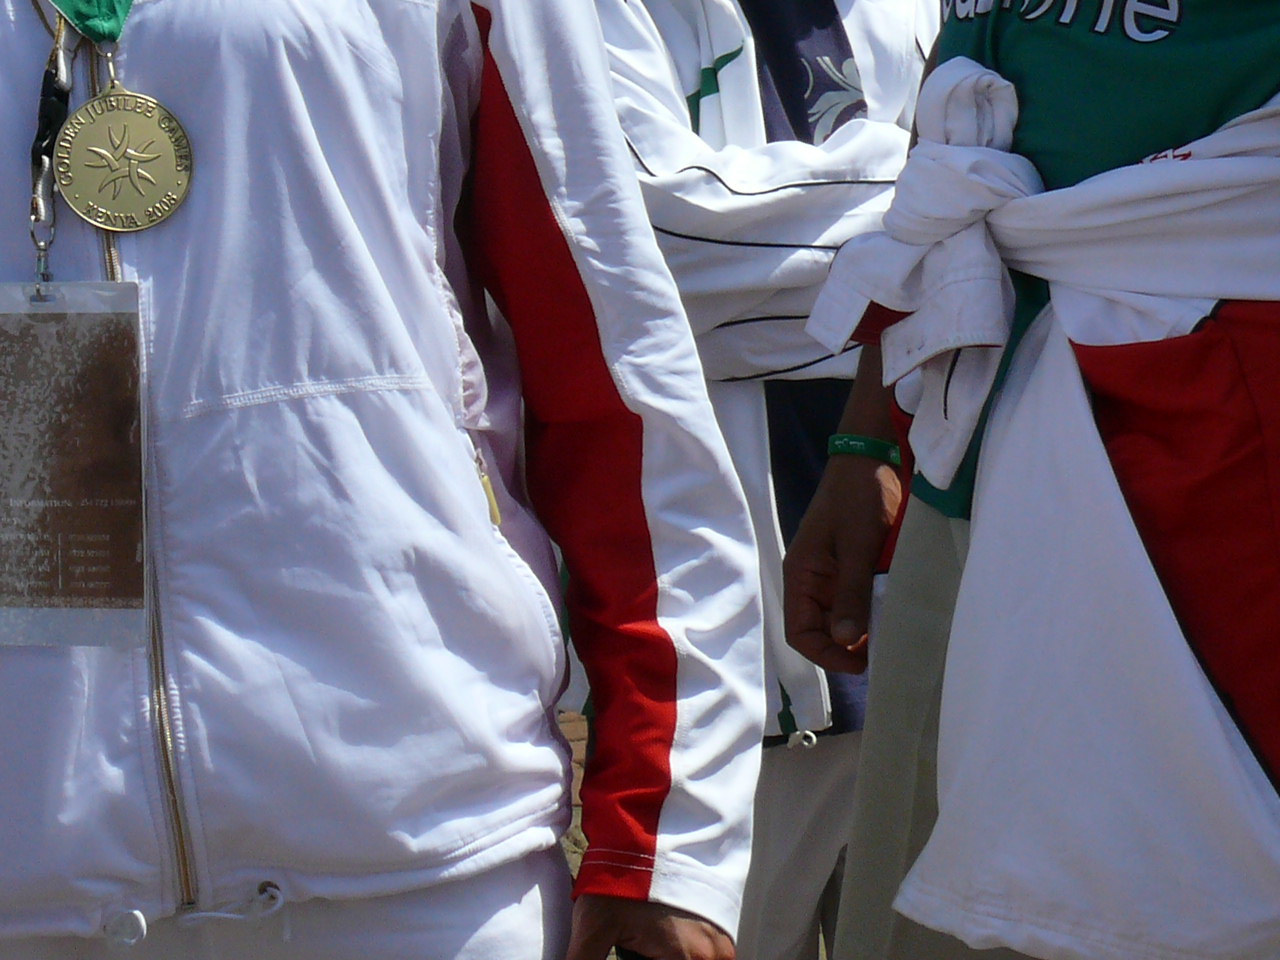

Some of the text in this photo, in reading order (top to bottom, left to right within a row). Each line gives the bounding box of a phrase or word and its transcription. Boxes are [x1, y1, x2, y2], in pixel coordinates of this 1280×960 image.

[56, 96, 190, 186] GOLDEN JUBILEE GAMES
[82, 191, 178, 228] KENYA 2008
